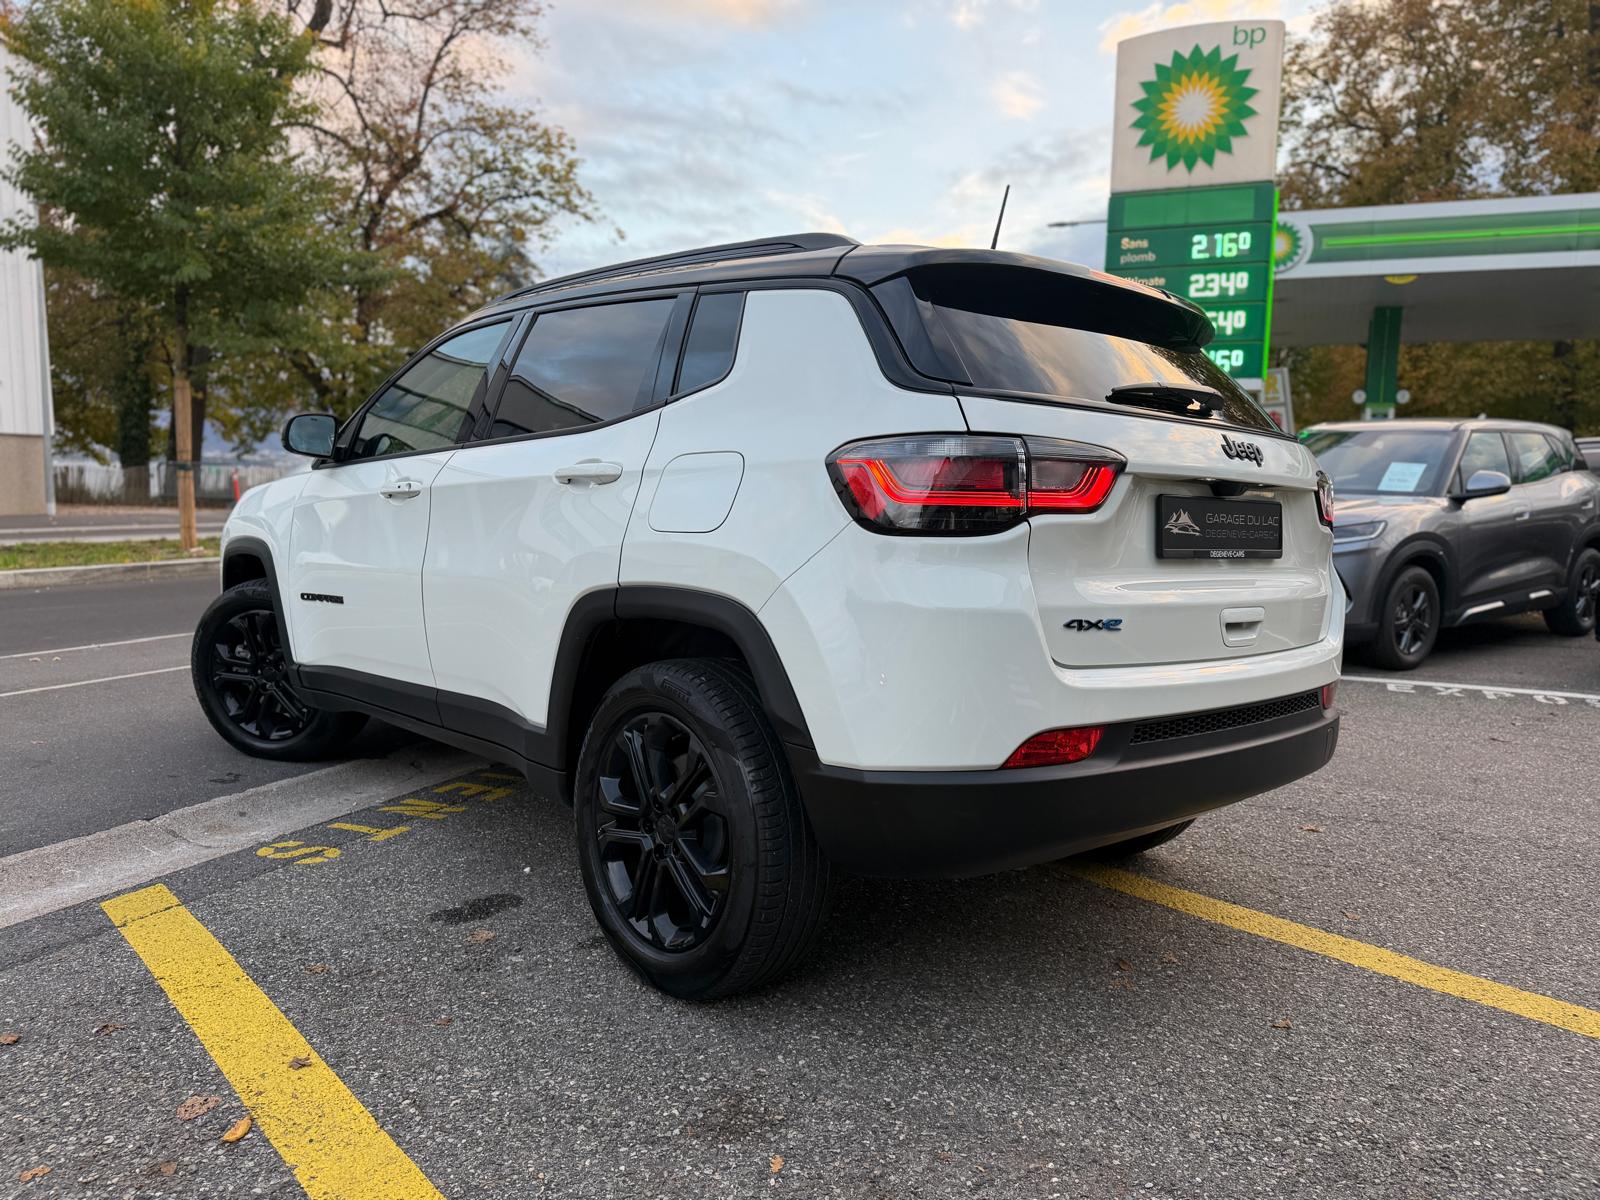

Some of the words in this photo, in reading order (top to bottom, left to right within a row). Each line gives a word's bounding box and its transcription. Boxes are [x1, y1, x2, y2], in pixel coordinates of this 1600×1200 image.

[1233, 25, 1267, 50] bp
[1120, 237, 1149, 250] Sans
[1120, 251, 1156, 265] plomb
[1221, 433, 1264, 468] Jeep
[1205, 513, 1246, 526] GARAGE
[1247, 514, 1261, 526] DU
[1262, 516, 1280, 527] LAC
